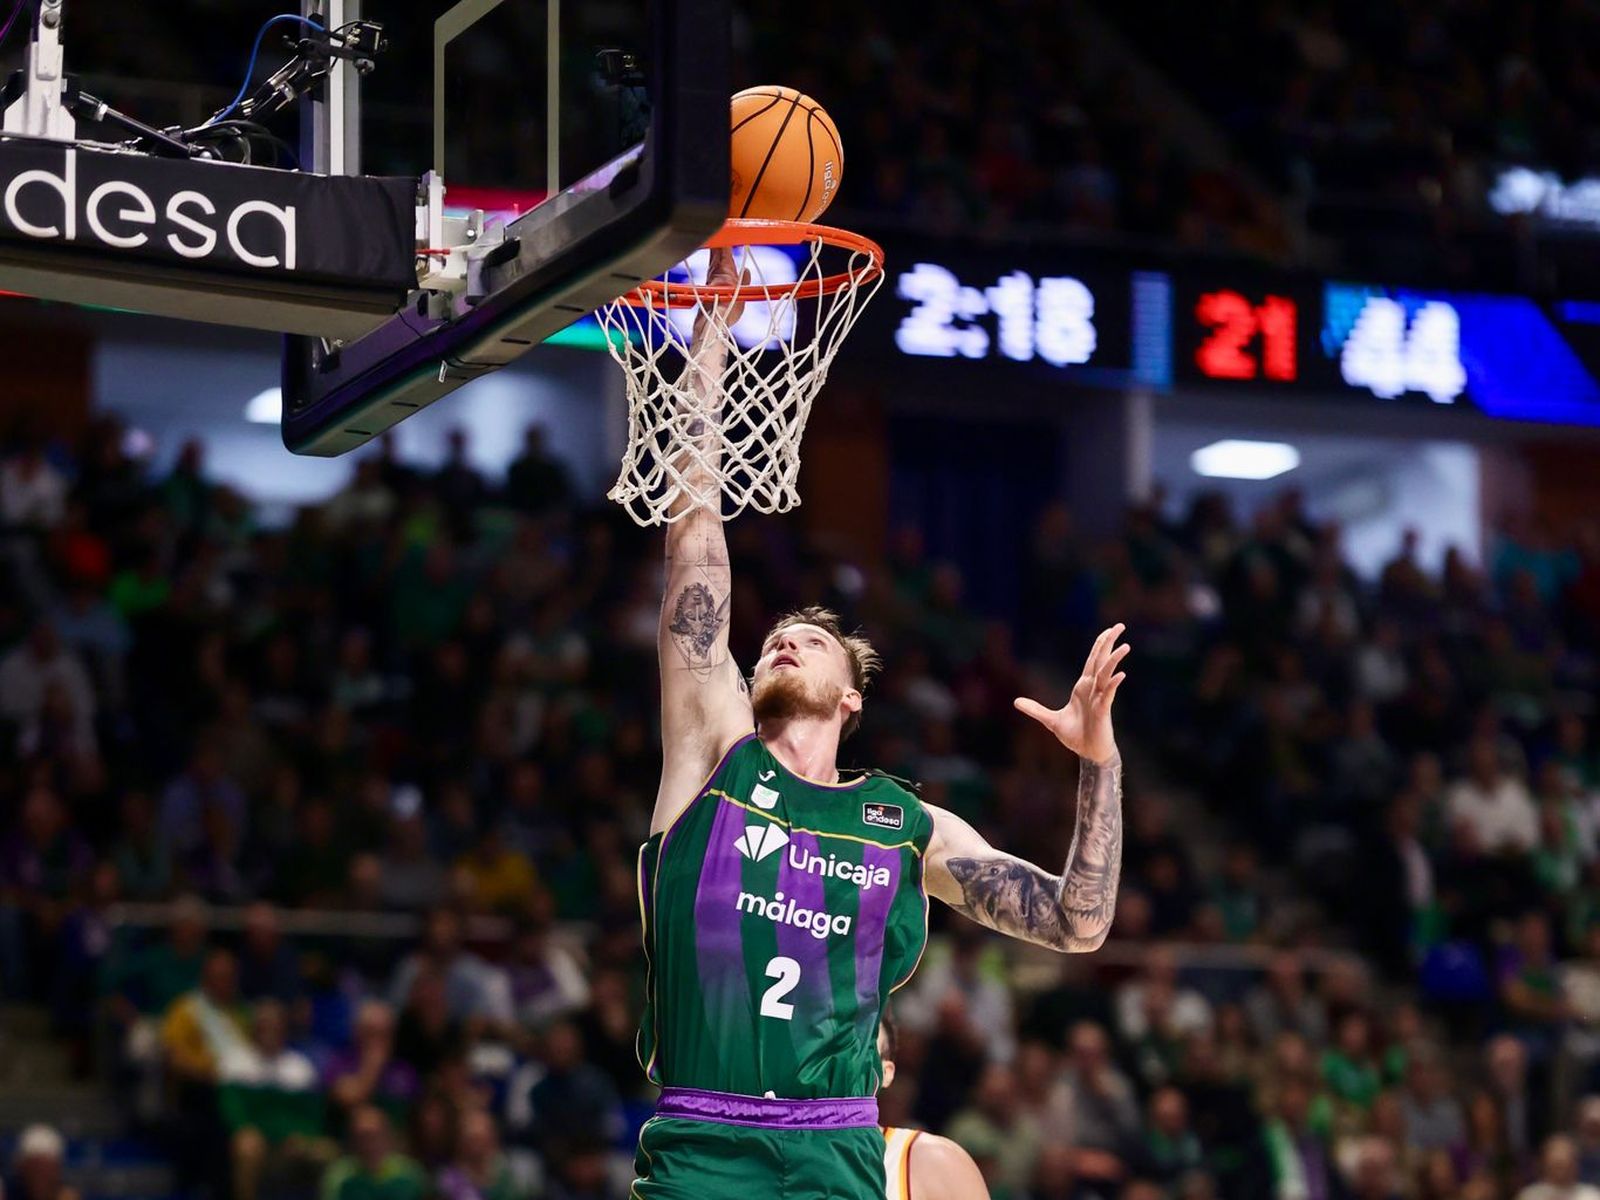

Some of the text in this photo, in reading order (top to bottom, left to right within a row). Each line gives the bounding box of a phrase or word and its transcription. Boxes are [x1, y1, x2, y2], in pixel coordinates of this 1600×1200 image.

[5, 149, 296, 270] desa
[1195, 288, 1298, 380] 21
[1340, 297, 1467, 404] 44
[867, 807, 882, 817] liga
[789, 845, 890, 890] Unicaja
[760, 956, 801, 1021] 2
